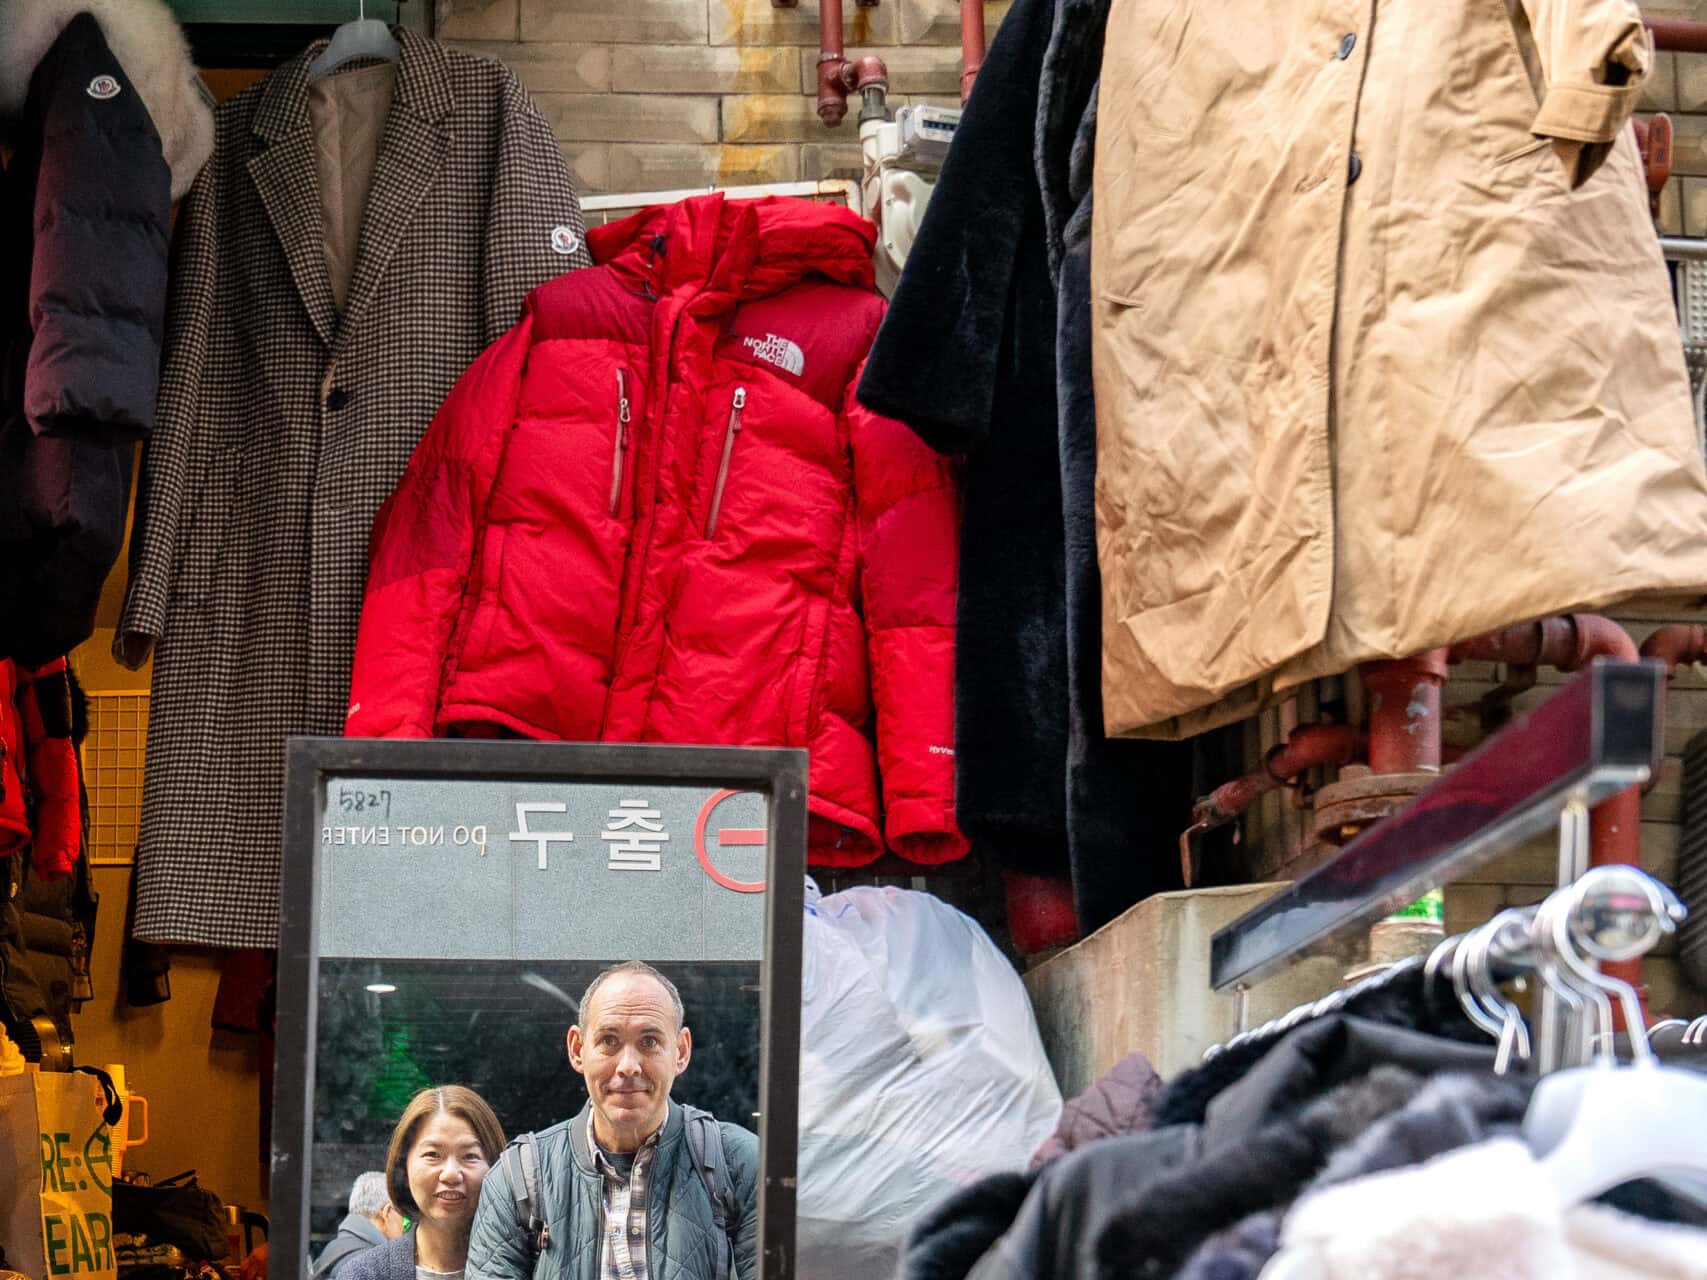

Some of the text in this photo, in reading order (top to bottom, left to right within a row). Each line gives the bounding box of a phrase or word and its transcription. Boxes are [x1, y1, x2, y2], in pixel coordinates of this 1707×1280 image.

[743, 336, 785, 359] NORTH
[765, 332, 788, 348] THE
[753, 349, 784, 367] FACE
[339, 787, 391, 819] 5827
